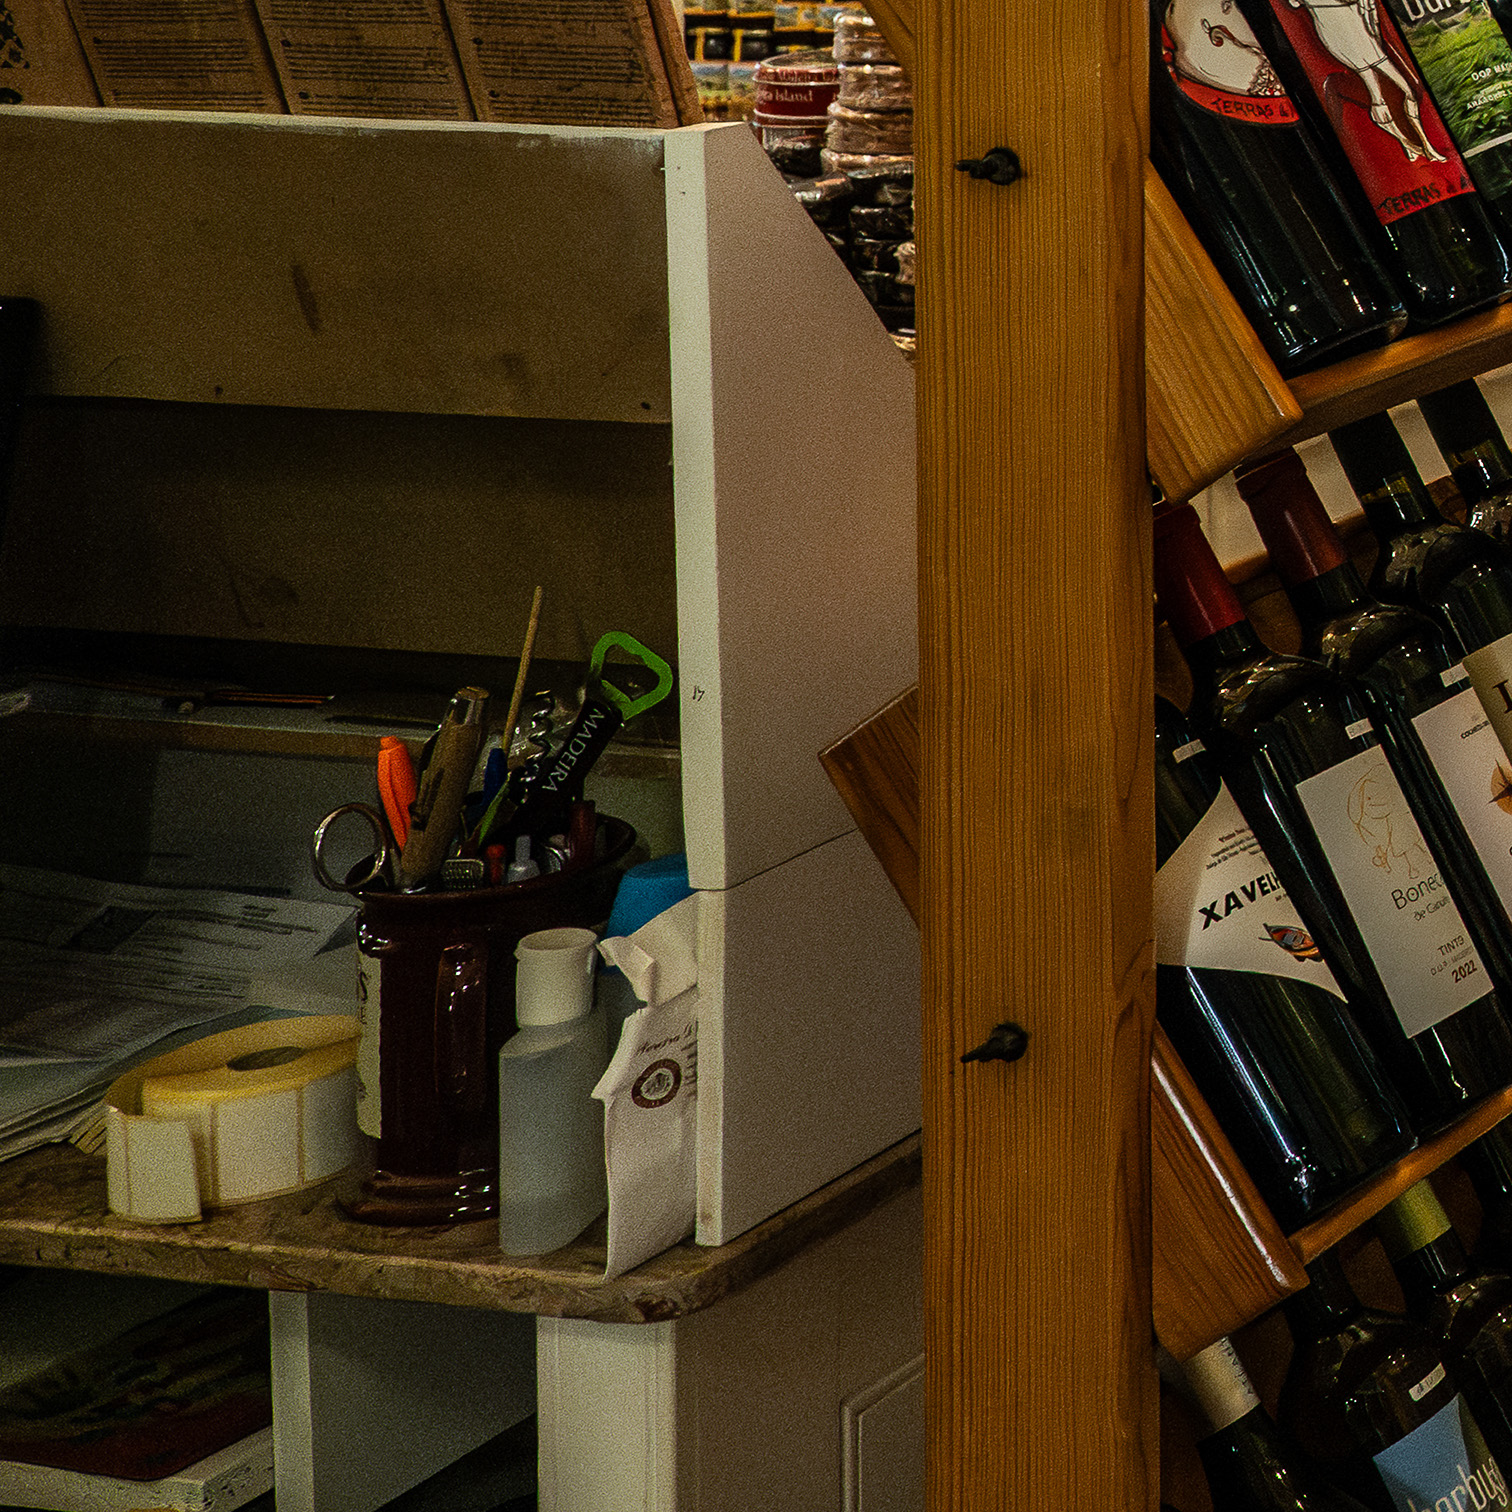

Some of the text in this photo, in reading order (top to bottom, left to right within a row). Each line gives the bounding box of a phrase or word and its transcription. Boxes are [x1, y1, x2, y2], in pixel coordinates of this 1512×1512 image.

[1210, 98, 1275, 116] TERRAS
[1377, 183, 1441, 215] TERRAS
[541, 707, 606, 792] MADEIRA
